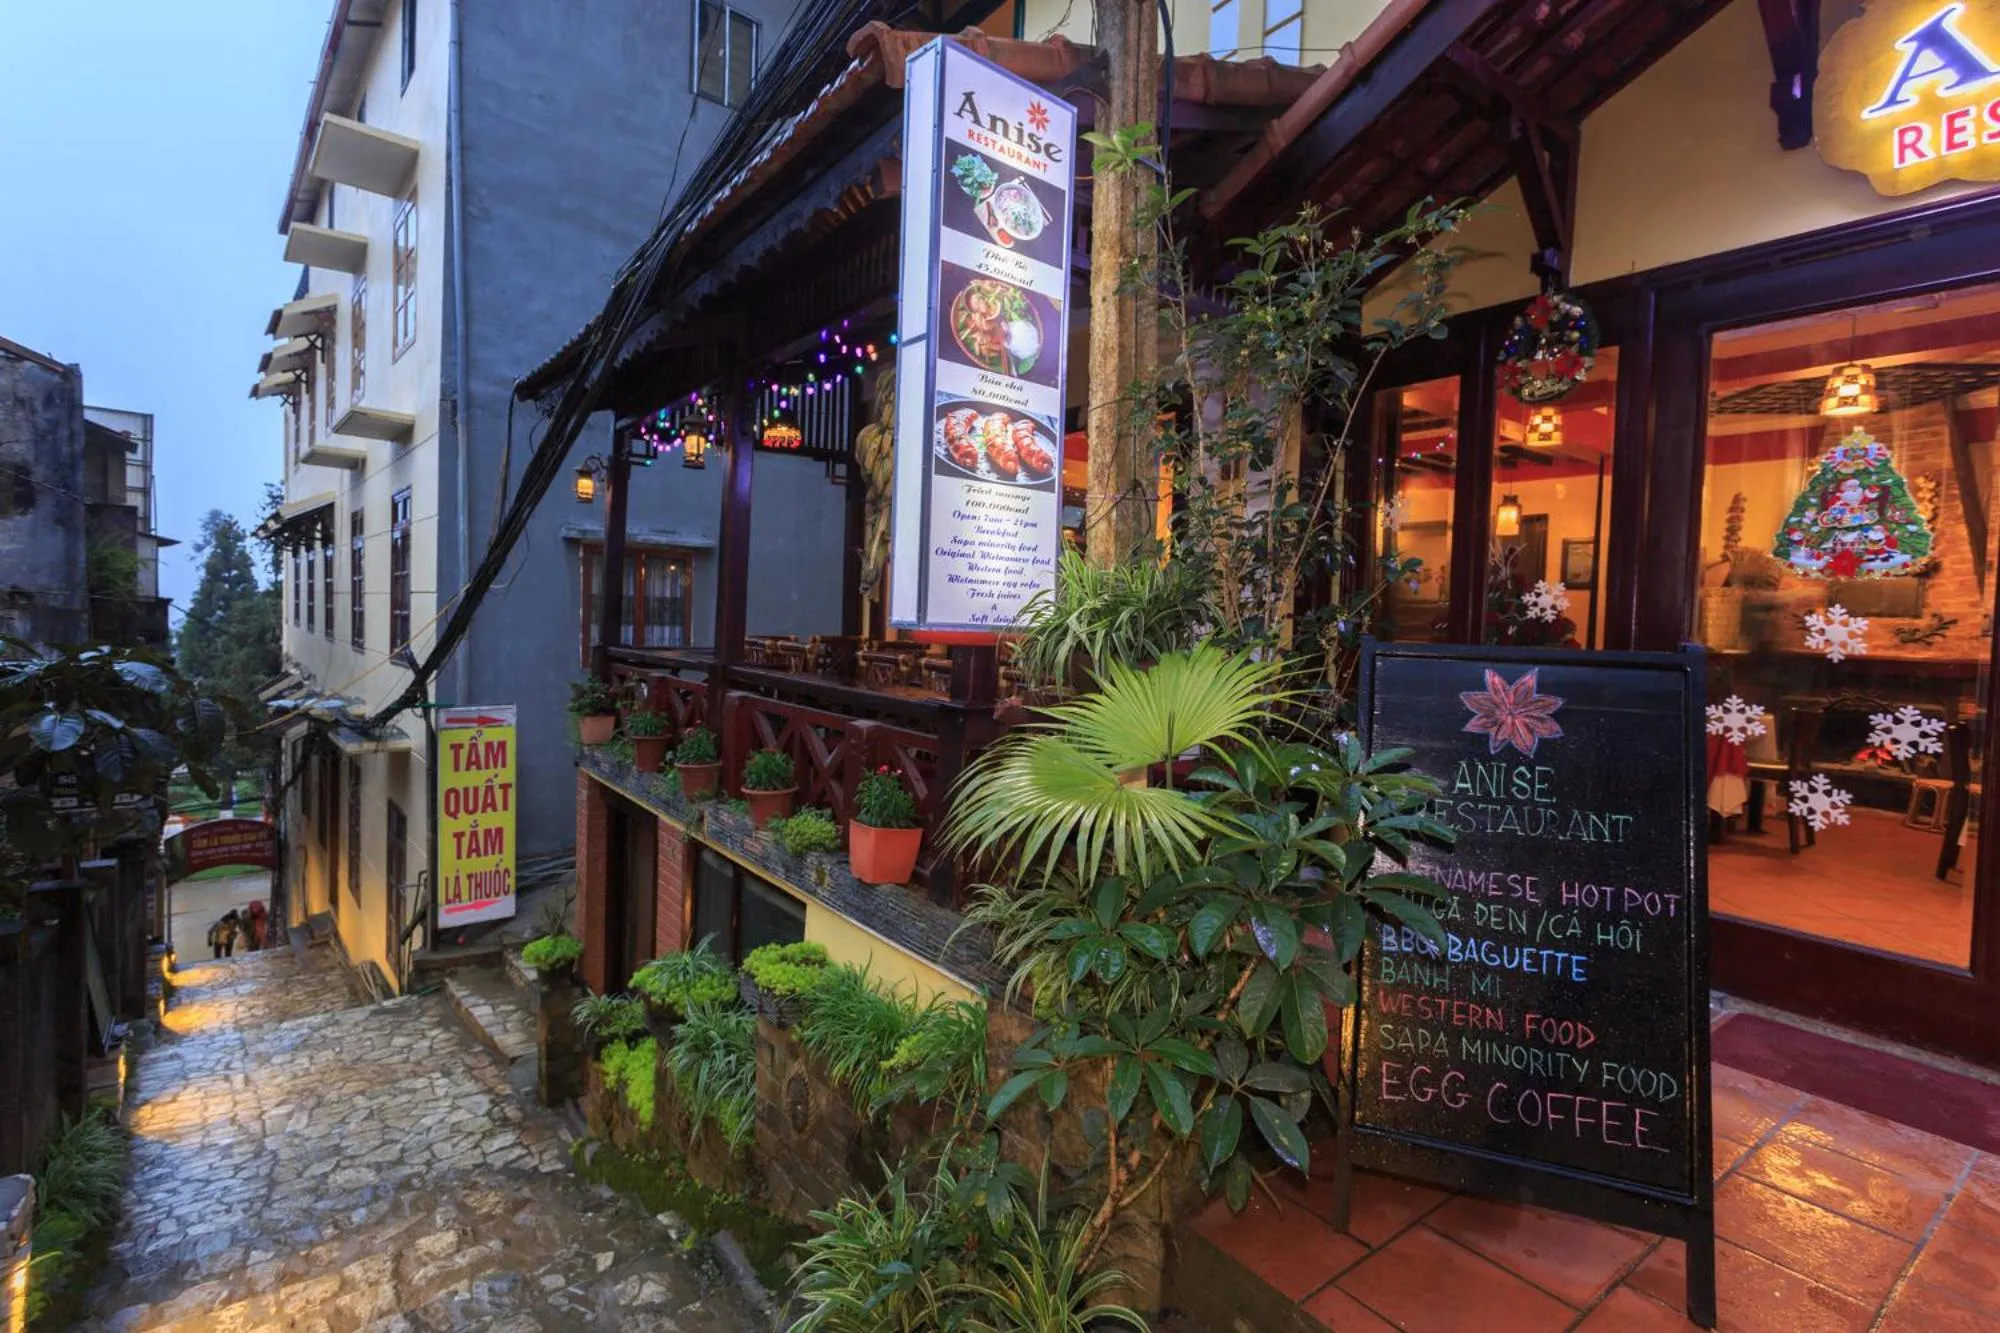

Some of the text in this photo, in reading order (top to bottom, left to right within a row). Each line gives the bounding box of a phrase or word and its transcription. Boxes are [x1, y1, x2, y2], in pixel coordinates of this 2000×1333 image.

[953, 91, 1063, 163] Anise
[967, 128, 1049, 174] RESTAURANT
[961, 484, 993, 495] Fried
[974, 524, 1019, 539] Breakfast
[935, 546, 976, 560] Original
[1031, 556, 1052, 567] food
[967, 561, 1001, 573] Western
[967, 588, 996, 600] Fresh
[968, 613, 989, 624] Soft
[444, 774, 513, 820] QUẤT
[1452, 760, 1557, 803] ANISE
[445, 858, 511, 904] LÁ THUỐC
[1380, 956, 1450, 993] BANH
[1446, 931, 1588, 982] BAGUETTE
[1377, 988, 1597, 1050] WESTERN FOOD
[1379, 1023, 1679, 1103] SAPA MINORITY FOOD
[1380, 1059, 1671, 1153] EGG COFFEE
